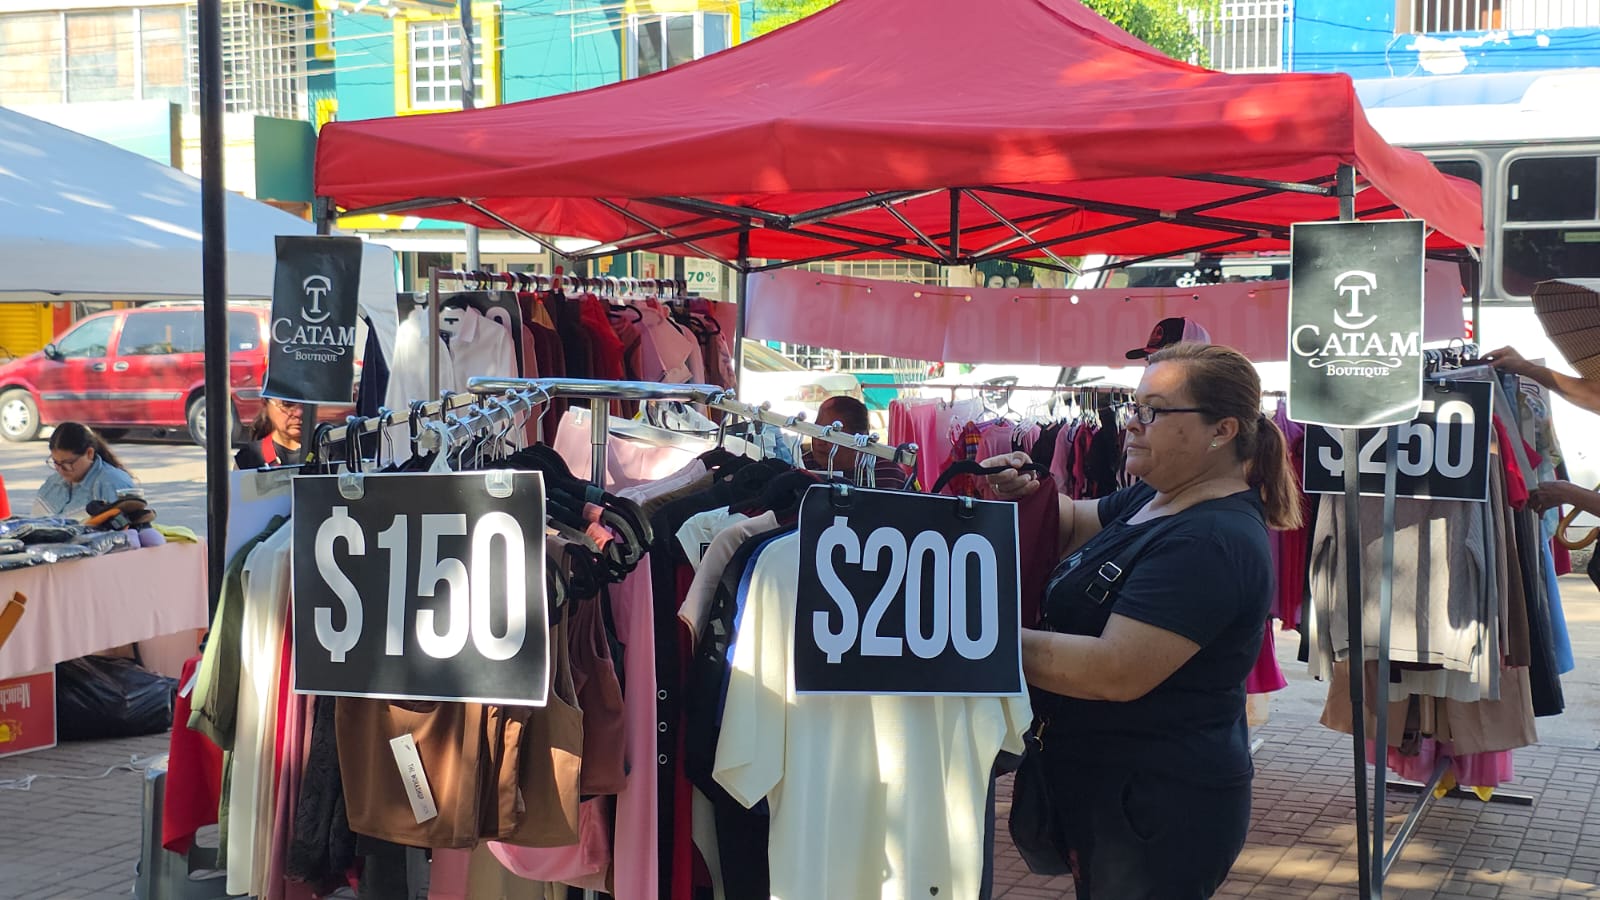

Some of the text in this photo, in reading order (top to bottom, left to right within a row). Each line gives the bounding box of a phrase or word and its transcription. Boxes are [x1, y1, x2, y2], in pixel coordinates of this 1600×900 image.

[687, 271, 717, 283] 70%
[271, 317, 356, 347] CATAM
[1291, 324, 1420, 357] CATAM
[295, 350, 338, 363] BOUTIQUE
[1326, 365, 1390, 377] BOUTIQUE
[313, 505, 528, 663] $150
[812, 515, 1000, 664] $200
